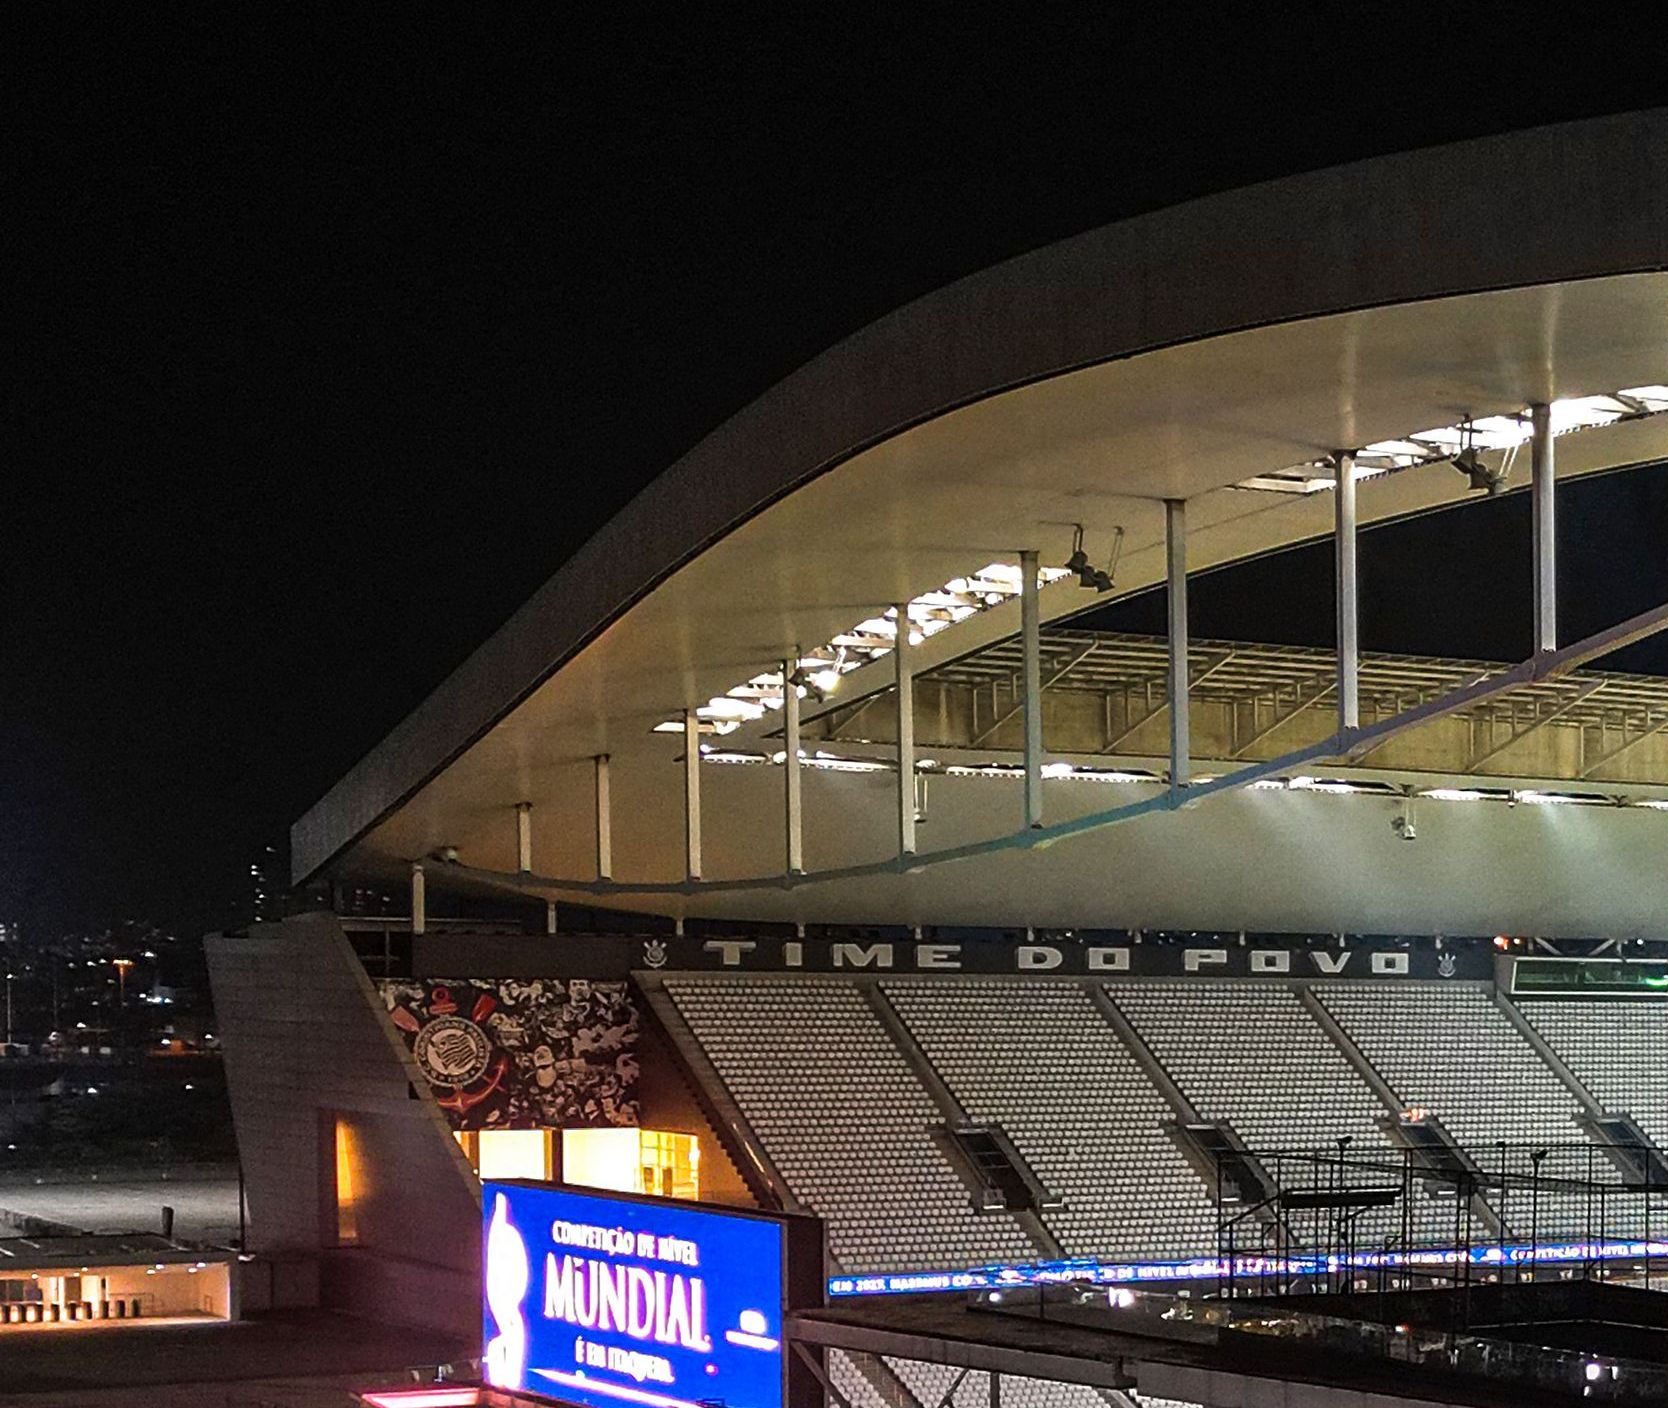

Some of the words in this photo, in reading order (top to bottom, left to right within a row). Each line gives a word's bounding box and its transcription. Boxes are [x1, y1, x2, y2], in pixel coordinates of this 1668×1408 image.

[703, 939, 963, 969] TIME
[1017, 945, 1130, 972] DO
[1183, 948, 1410, 974] POVO
[552, 1219, 635, 1256] COMPETIÇÃO
[636, 1233, 656, 1258] DE
